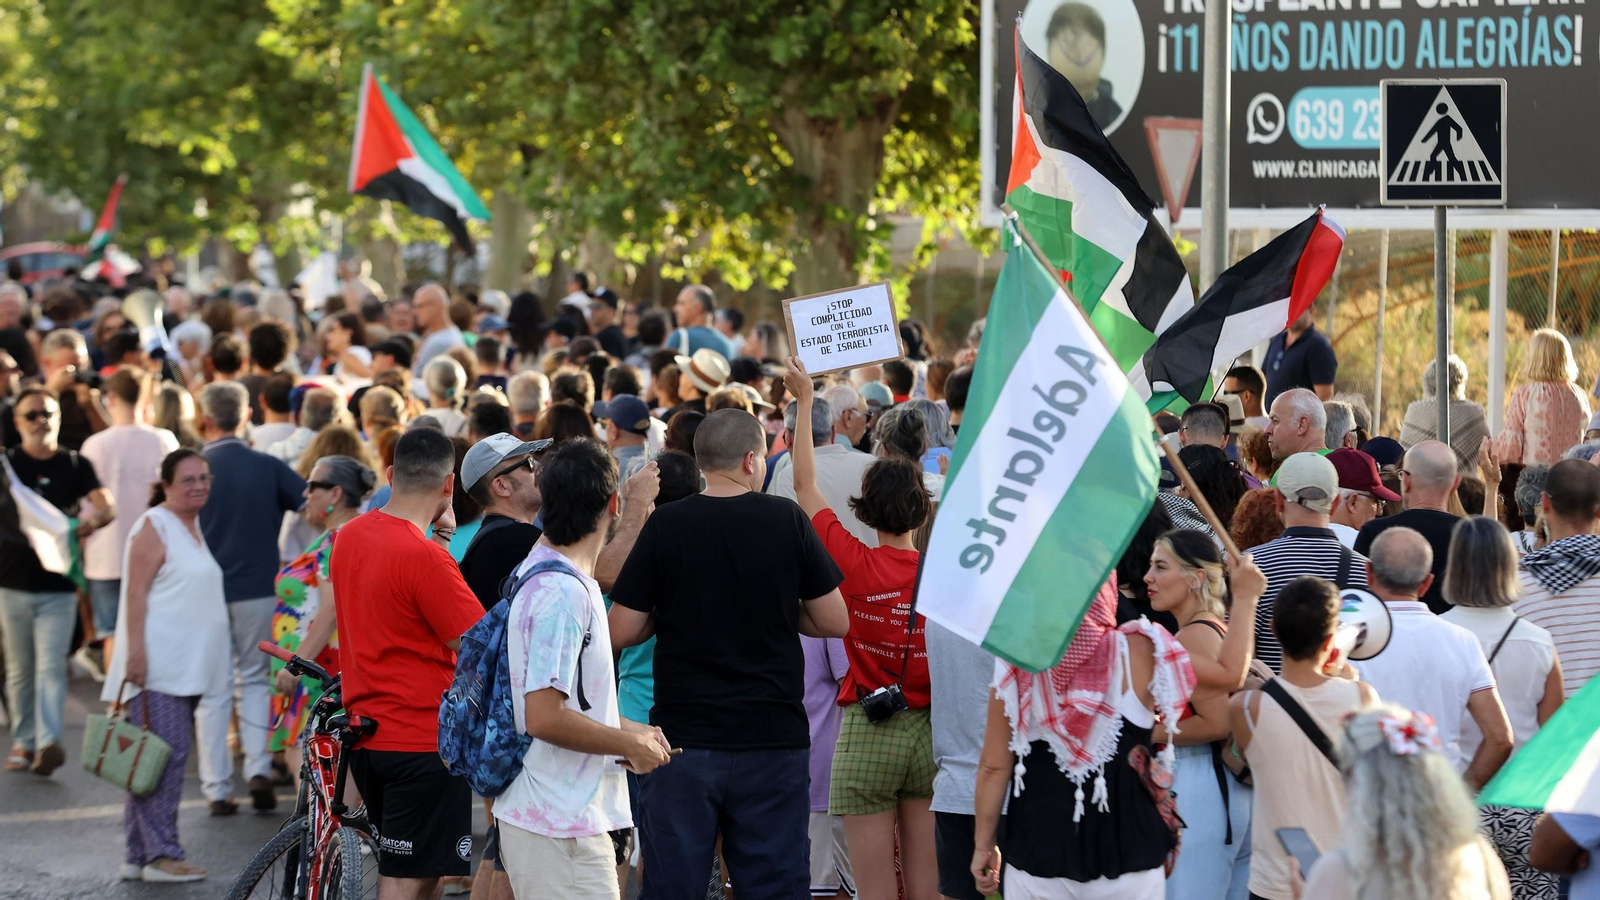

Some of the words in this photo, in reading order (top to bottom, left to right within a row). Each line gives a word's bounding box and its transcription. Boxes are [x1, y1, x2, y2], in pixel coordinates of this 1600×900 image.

[1158, 23, 1199, 73] ¡11
[1231, 14, 1290, 73] ÑOS
[1299, 18, 1406, 71] DANDO
[1415, 6, 1583, 70] ALEGRÍAS!
[1295, 98, 1345, 141] 639
[1252, 159, 1380, 179] WWW.CLINICAGA
[827, 298, 853, 314] ¡STOP
[811, 306, 872, 326] COMPLICIDAD
[830, 323, 844, 331] CON
[847, 320, 857, 328] EL
[801, 334, 832, 348] ESTADO
[837, 323, 889, 341] TERRORISTA
[820, 345, 832, 355] DE
[837, 337, 873, 352] ISRAEL!
[866, 592, 901, 602] DENNISON
[854, 610, 885, 622] PLEASING
[853, 641, 896, 659] LINTONVILLE,
